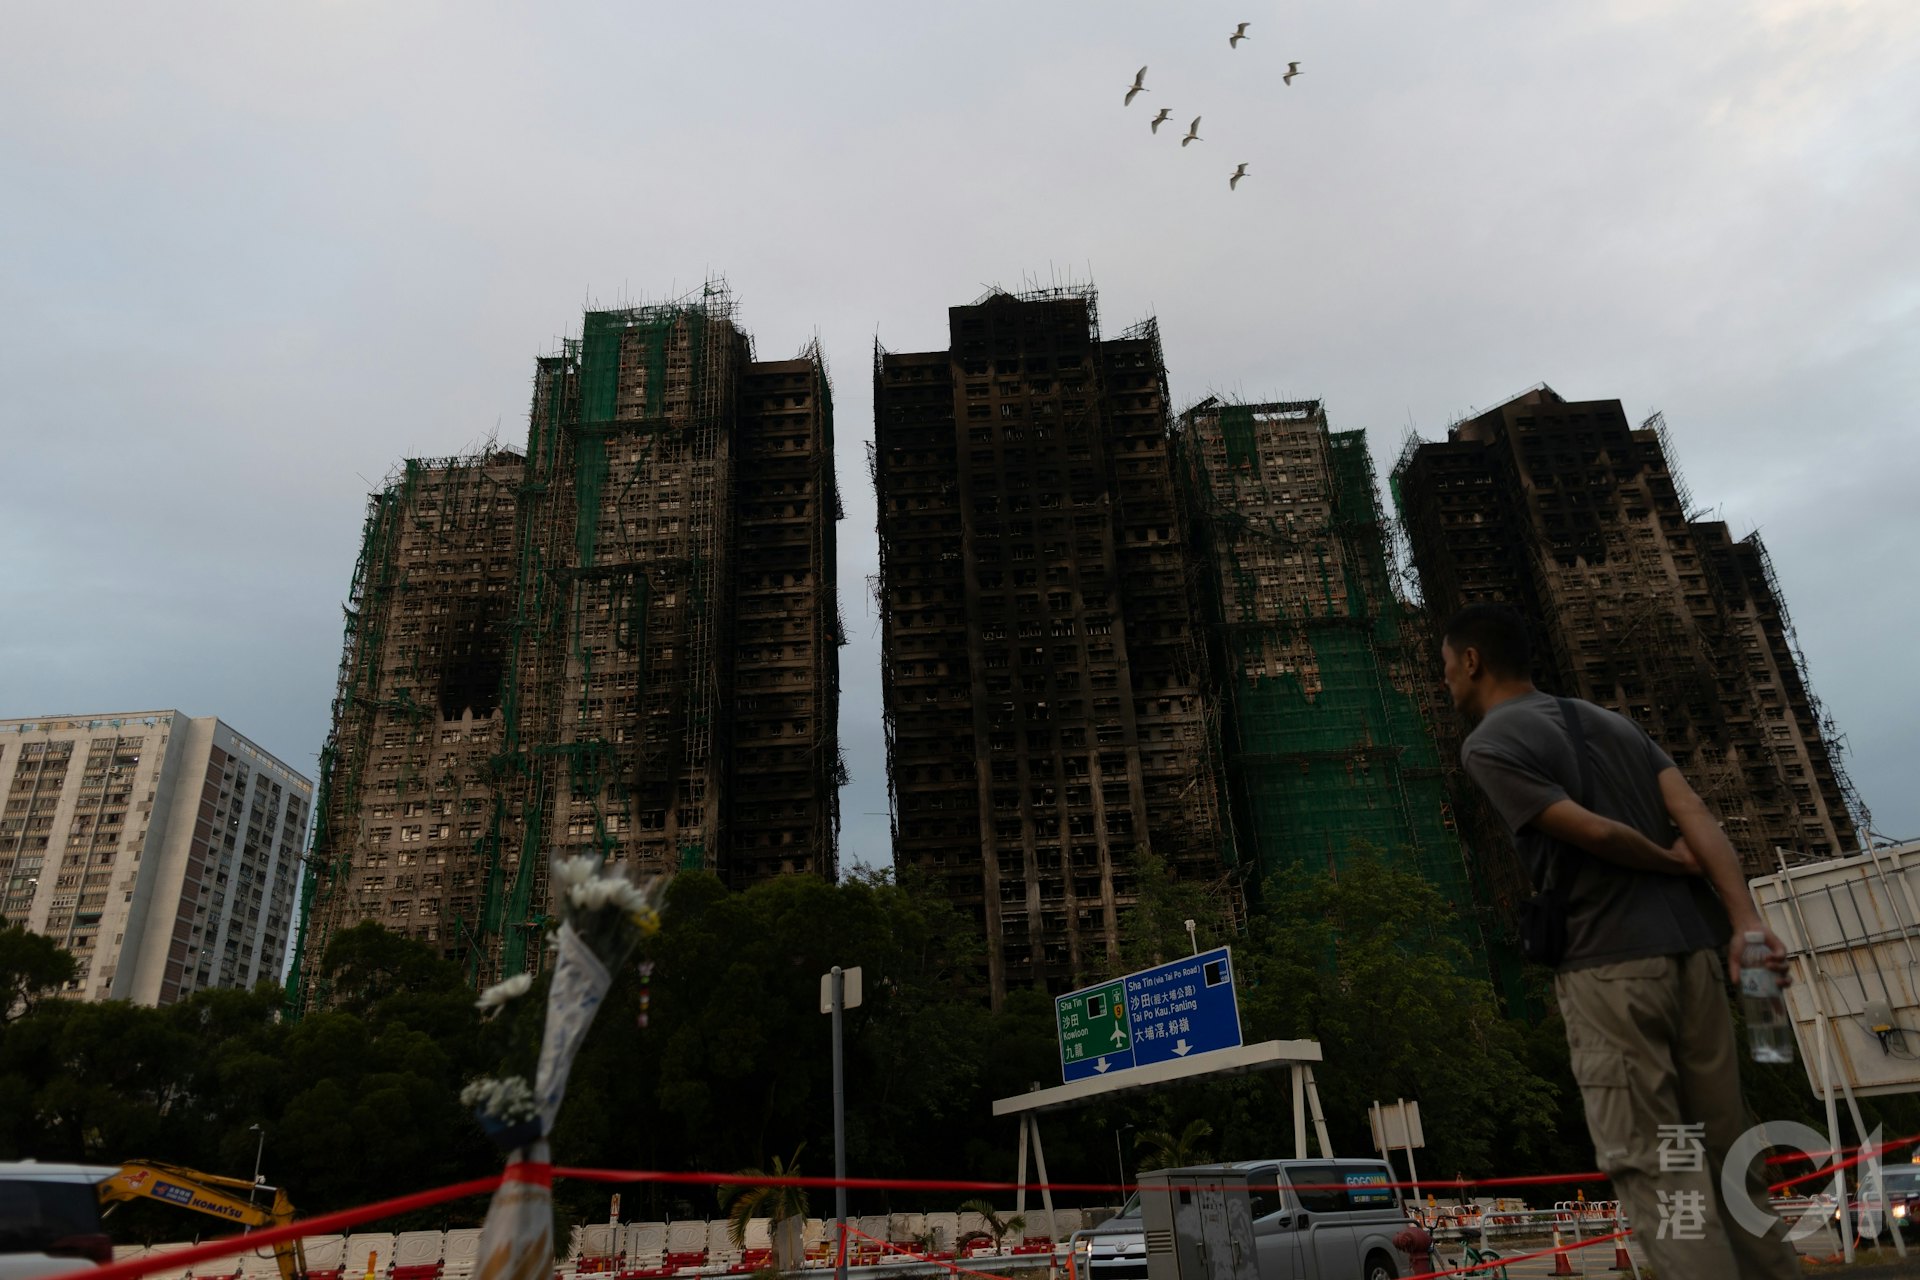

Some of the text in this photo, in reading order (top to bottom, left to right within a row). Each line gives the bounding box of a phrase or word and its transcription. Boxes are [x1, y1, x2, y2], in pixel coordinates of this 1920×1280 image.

[1128, 981, 1140, 992] Sha
[1142, 977, 1154, 988] Tin
[1164, 972, 1173, 981] Tai
[1173, 970, 1182, 979] Po
[1060, 998, 1083, 1011] Sha Tin
[1116, 1006, 1121, 1016] 9
[1062, 1013, 1079, 1030] 沙田
[1132, 1012, 1143, 1023] Tai
[1143, 1010, 1154, 1020] Po
[1063, 1027, 1089, 1041] Kowloon
[1065, 1042, 1084, 1060] 九龍
[192, 1198, 243, 1218] KOMATSU
